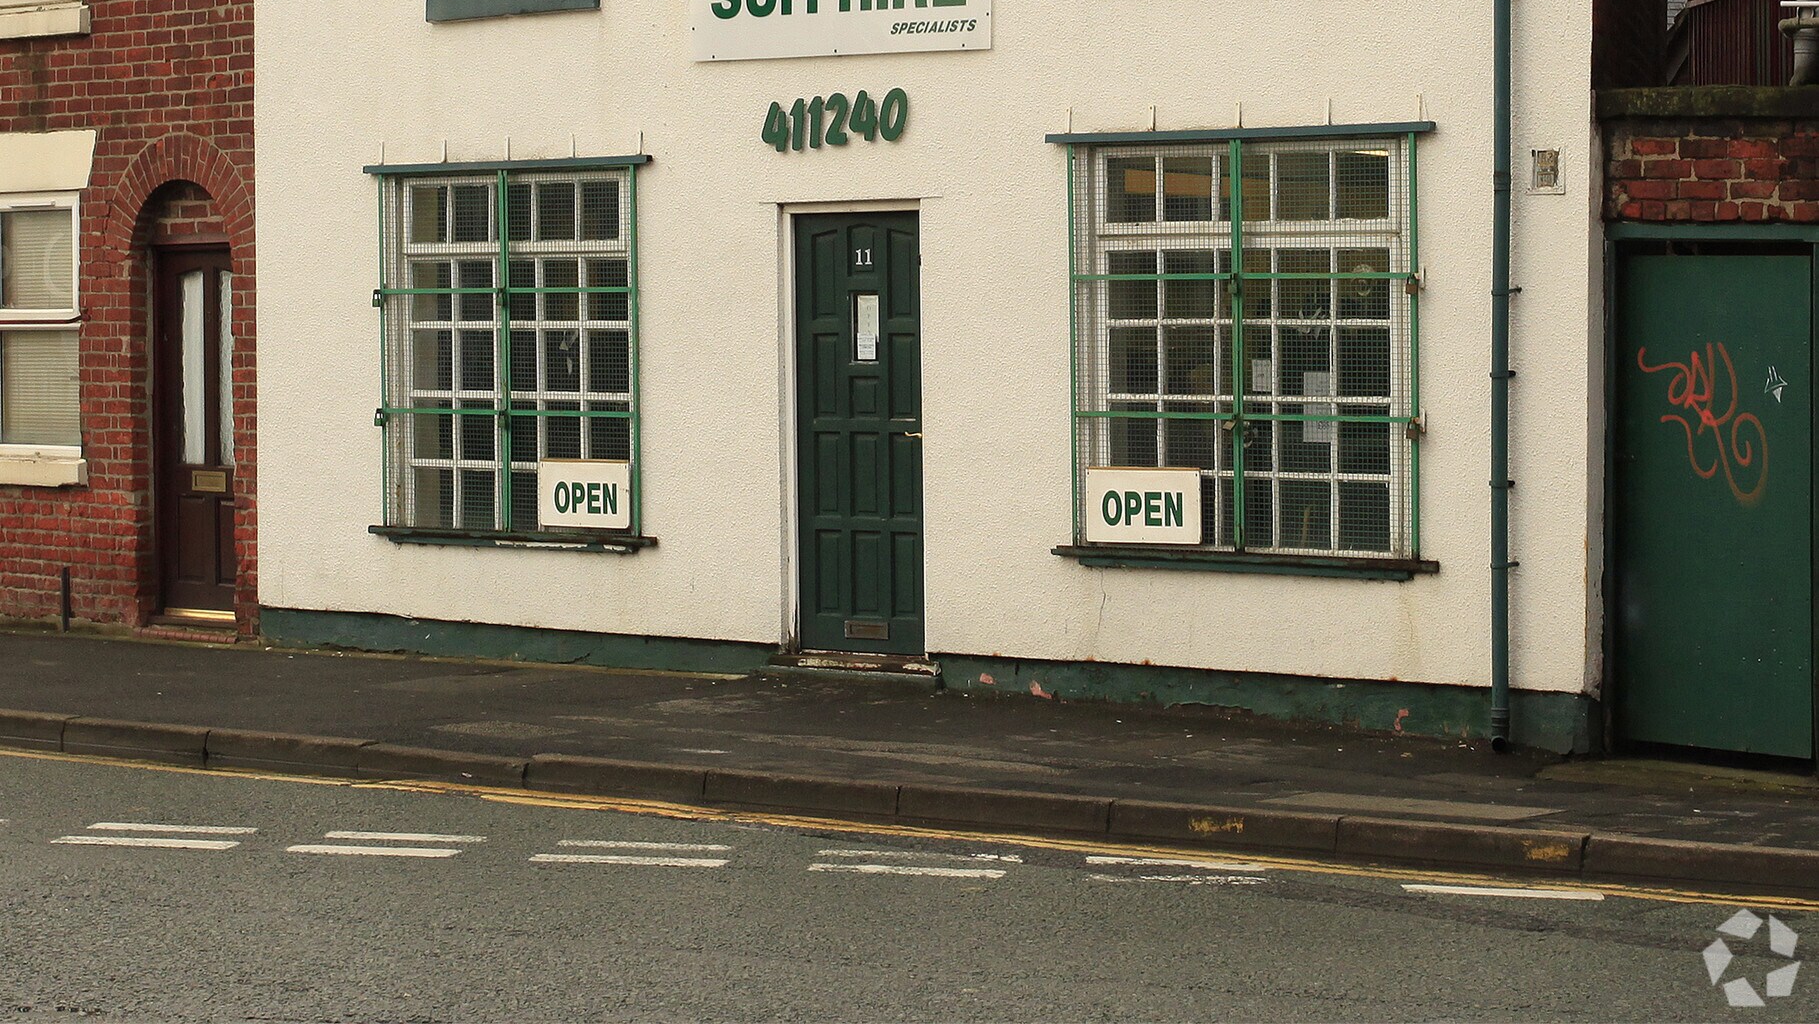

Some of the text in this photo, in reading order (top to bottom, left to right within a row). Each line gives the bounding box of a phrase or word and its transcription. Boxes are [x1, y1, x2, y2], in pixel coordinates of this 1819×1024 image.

[891, 20, 976, 34] SPECIALISTS
[762, 88, 908, 153] 411240
[855, 248, 873, 266] 11
[555, 482, 617, 514] OPEN
[1102, 491, 1183, 527] OPEN
